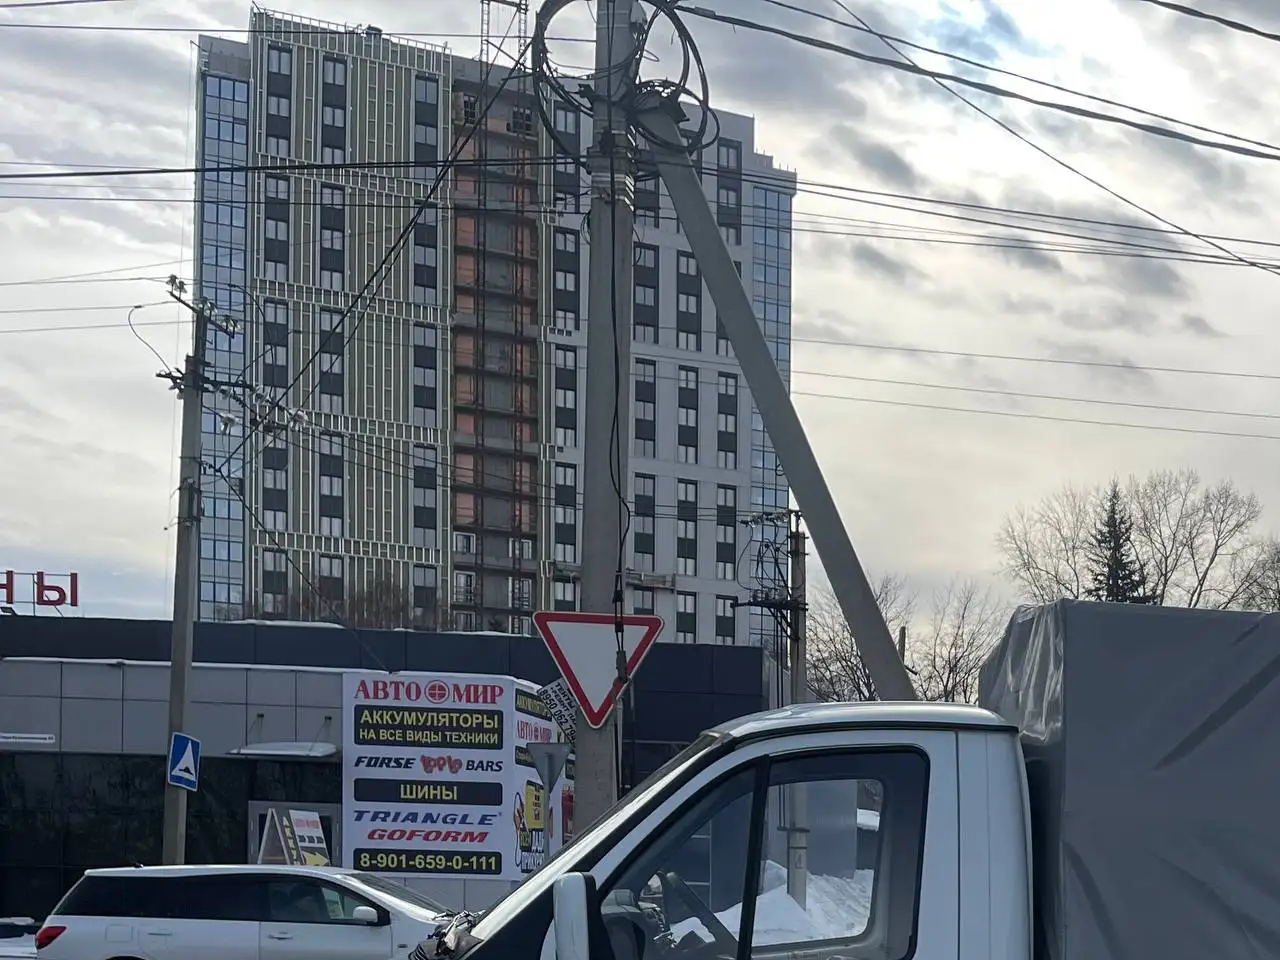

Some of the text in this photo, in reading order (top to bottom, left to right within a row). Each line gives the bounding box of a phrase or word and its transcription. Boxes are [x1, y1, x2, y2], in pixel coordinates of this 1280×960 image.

[354, 679, 504, 705] АВТО МИР
[360, 709, 499, 729] АККУМУЛЯТОРЫ
[359, 728, 498, 744] НА ВСЕ ВИДЫ ТЕХНИКИ
[354, 756, 416, 769] FORSE
[465, 759, 503, 772] BARS
[400, 784, 457, 801] ШИНЫ
[353, 810, 498, 826] TRIANGLE
[367, 828, 489, 844] GOFORM
[360, 852, 497, 871] 8-901-659-0-111
